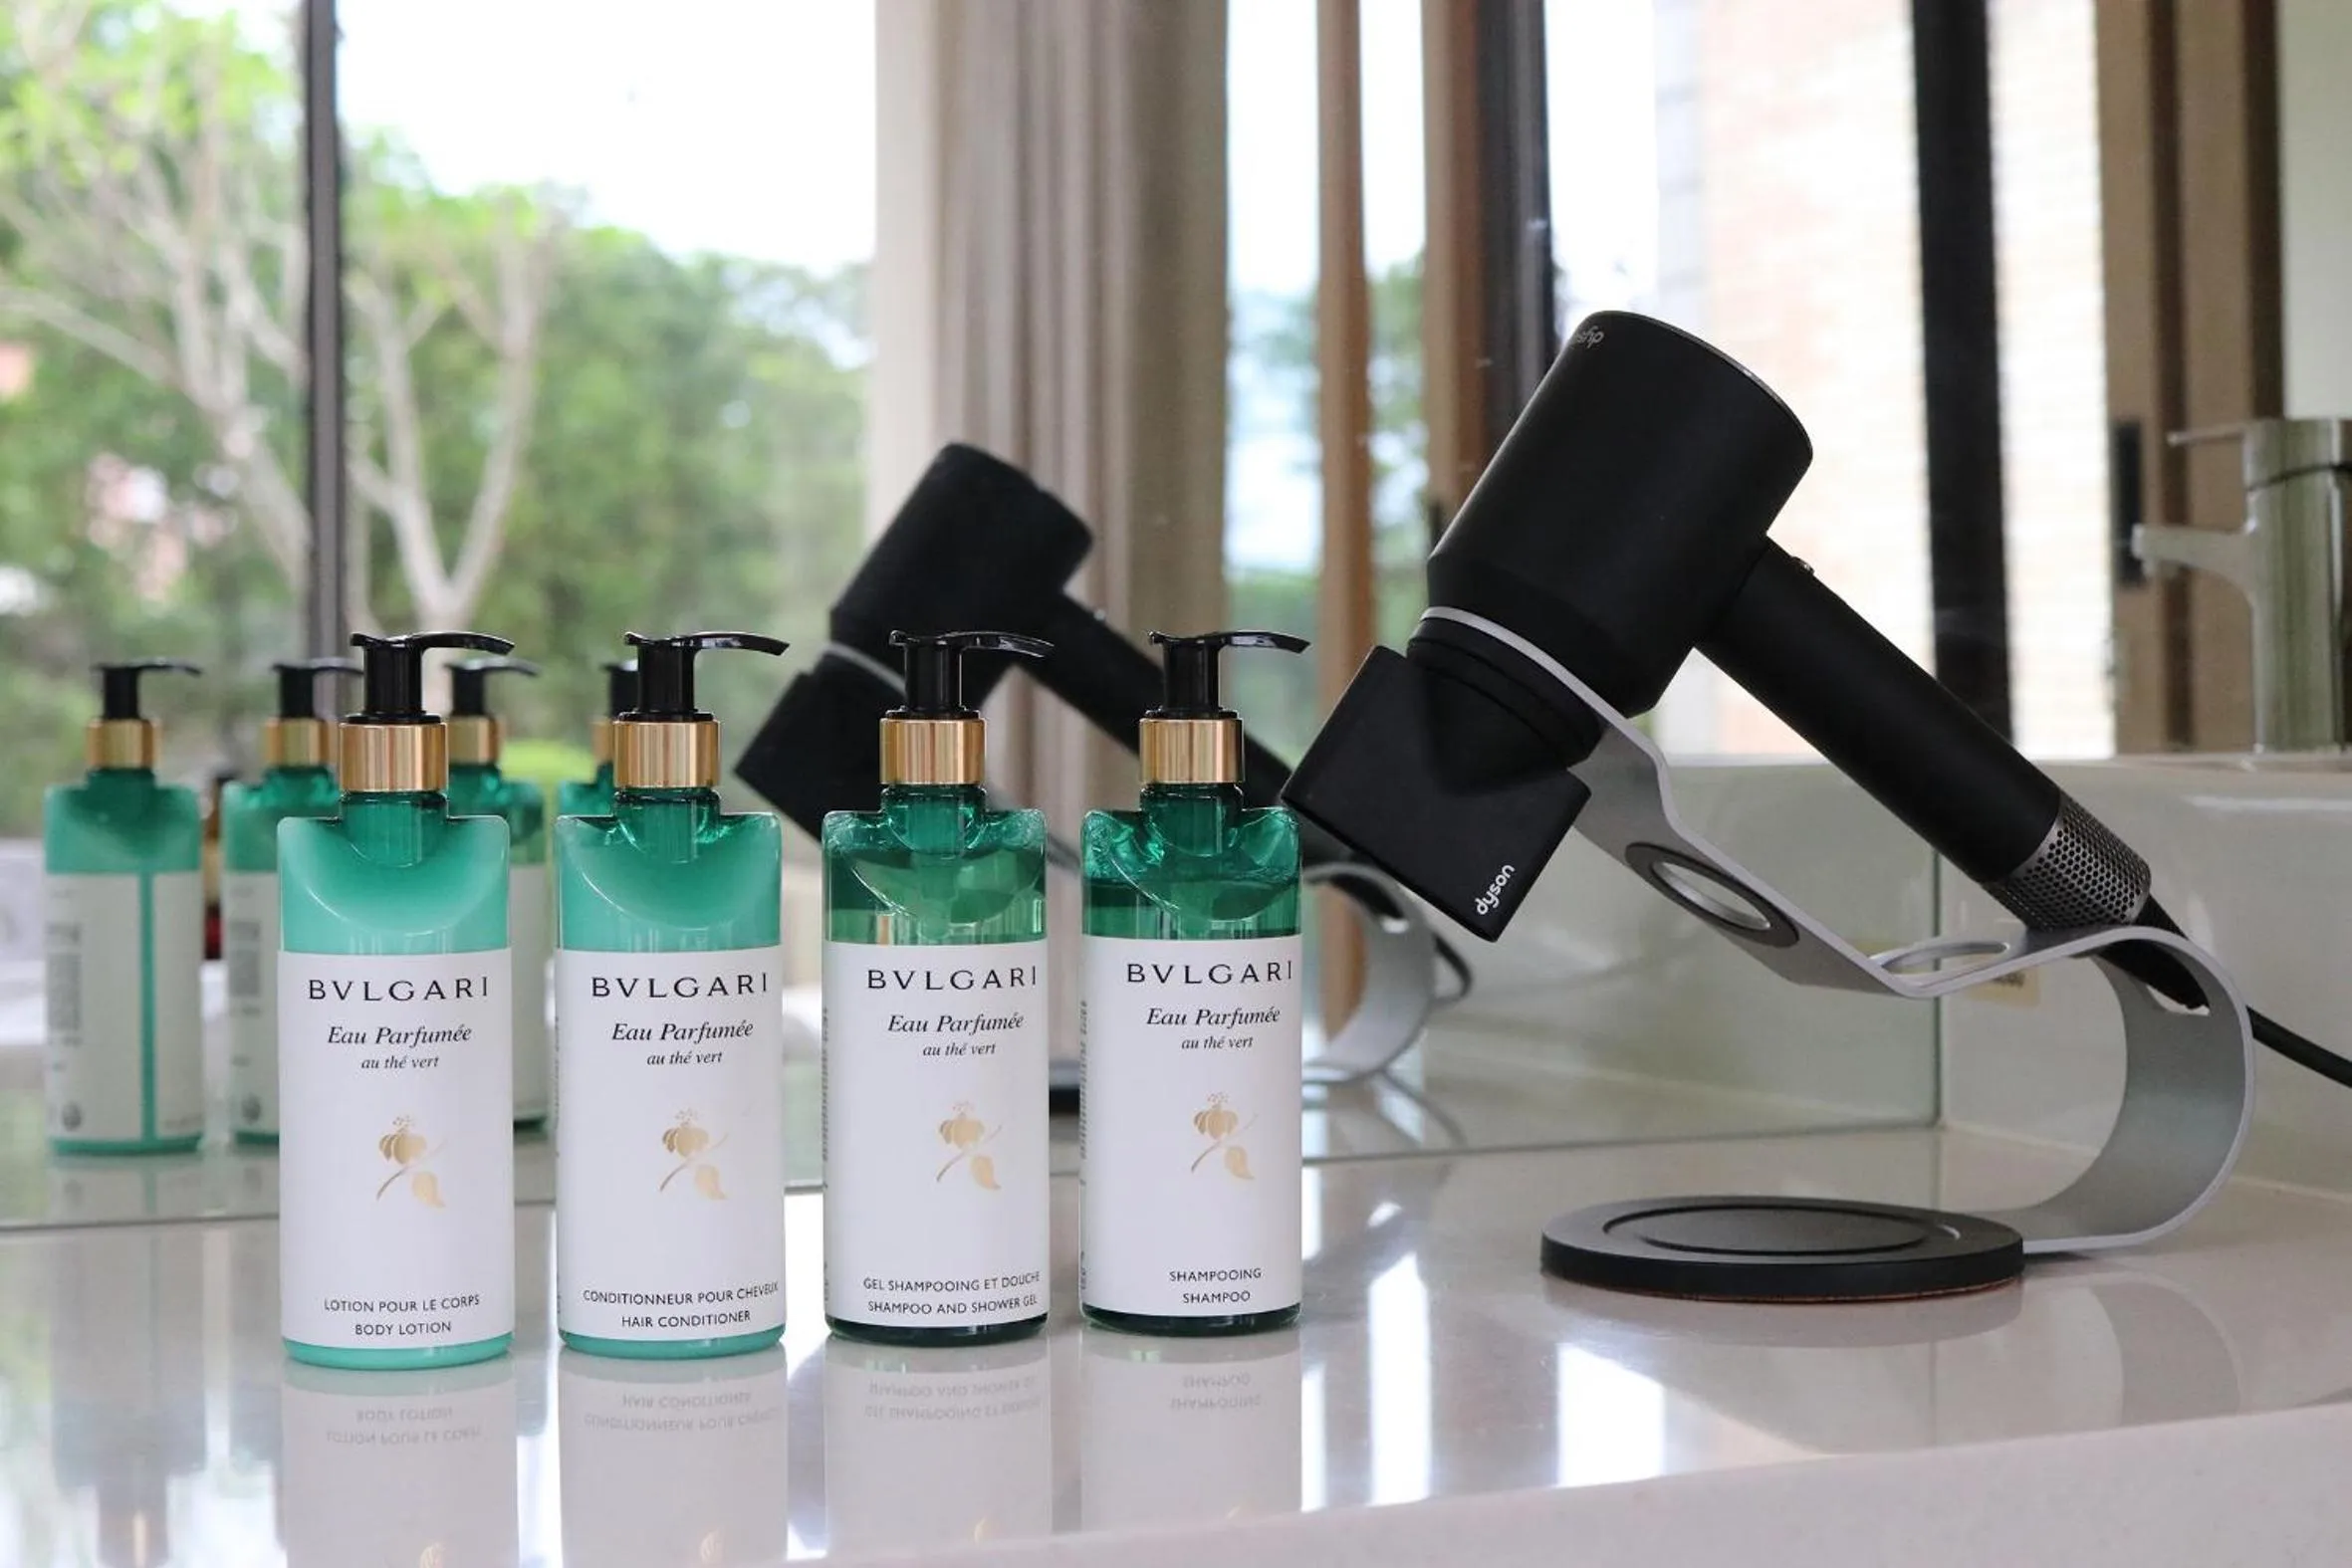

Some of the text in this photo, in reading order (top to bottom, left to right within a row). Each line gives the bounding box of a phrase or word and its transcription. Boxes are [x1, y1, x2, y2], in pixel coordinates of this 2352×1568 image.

[1475, 864, 1515, 915] dyson
[867, 965, 1037, 991] BVLGARI
[1126, 959, 1293, 986] BVLGARI
[308, 976, 488, 1003] BVLGARI
[591, 972, 768, 999] BVLGARI
[887, 1011, 1025, 1036] Eau Parfumée
[1145, 1006, 1281, 1030] Eau Parfumée
[327, 1023, 473, 1049] Eau Parfumée
[611, 1018, 754, 1045] Eau Parfumée
[922, 1041, 997, 1056] au thé vert
[1181, 1035, 1254, 1050] au thé vert
[360, 1054, 440, 1069] au thé vert
[646, 1050, 723, 1066] au thé vert
[862, 1270, 1040, 1293] GEL SHAMPOOING ET DOUCHE
[1169, 1267, 1262, 1282] SHAMPOOING
[324, 1293, 480, 1314] LOTION POUR LE CORPS
[583, 1289, 694, 1306] CONDITIONNEUR
[697, 1289, 734, 1304] POUR
[867, 1294, 1038, 1315] SHAMPOO AND SHOWER GEL
[1182, 1289, 1251, 1304] SHAMPOO
[354, 1320, 452, 1336] BODY LOTION
[621, 1310, 751, 1328] HAIR CONDITIONER
